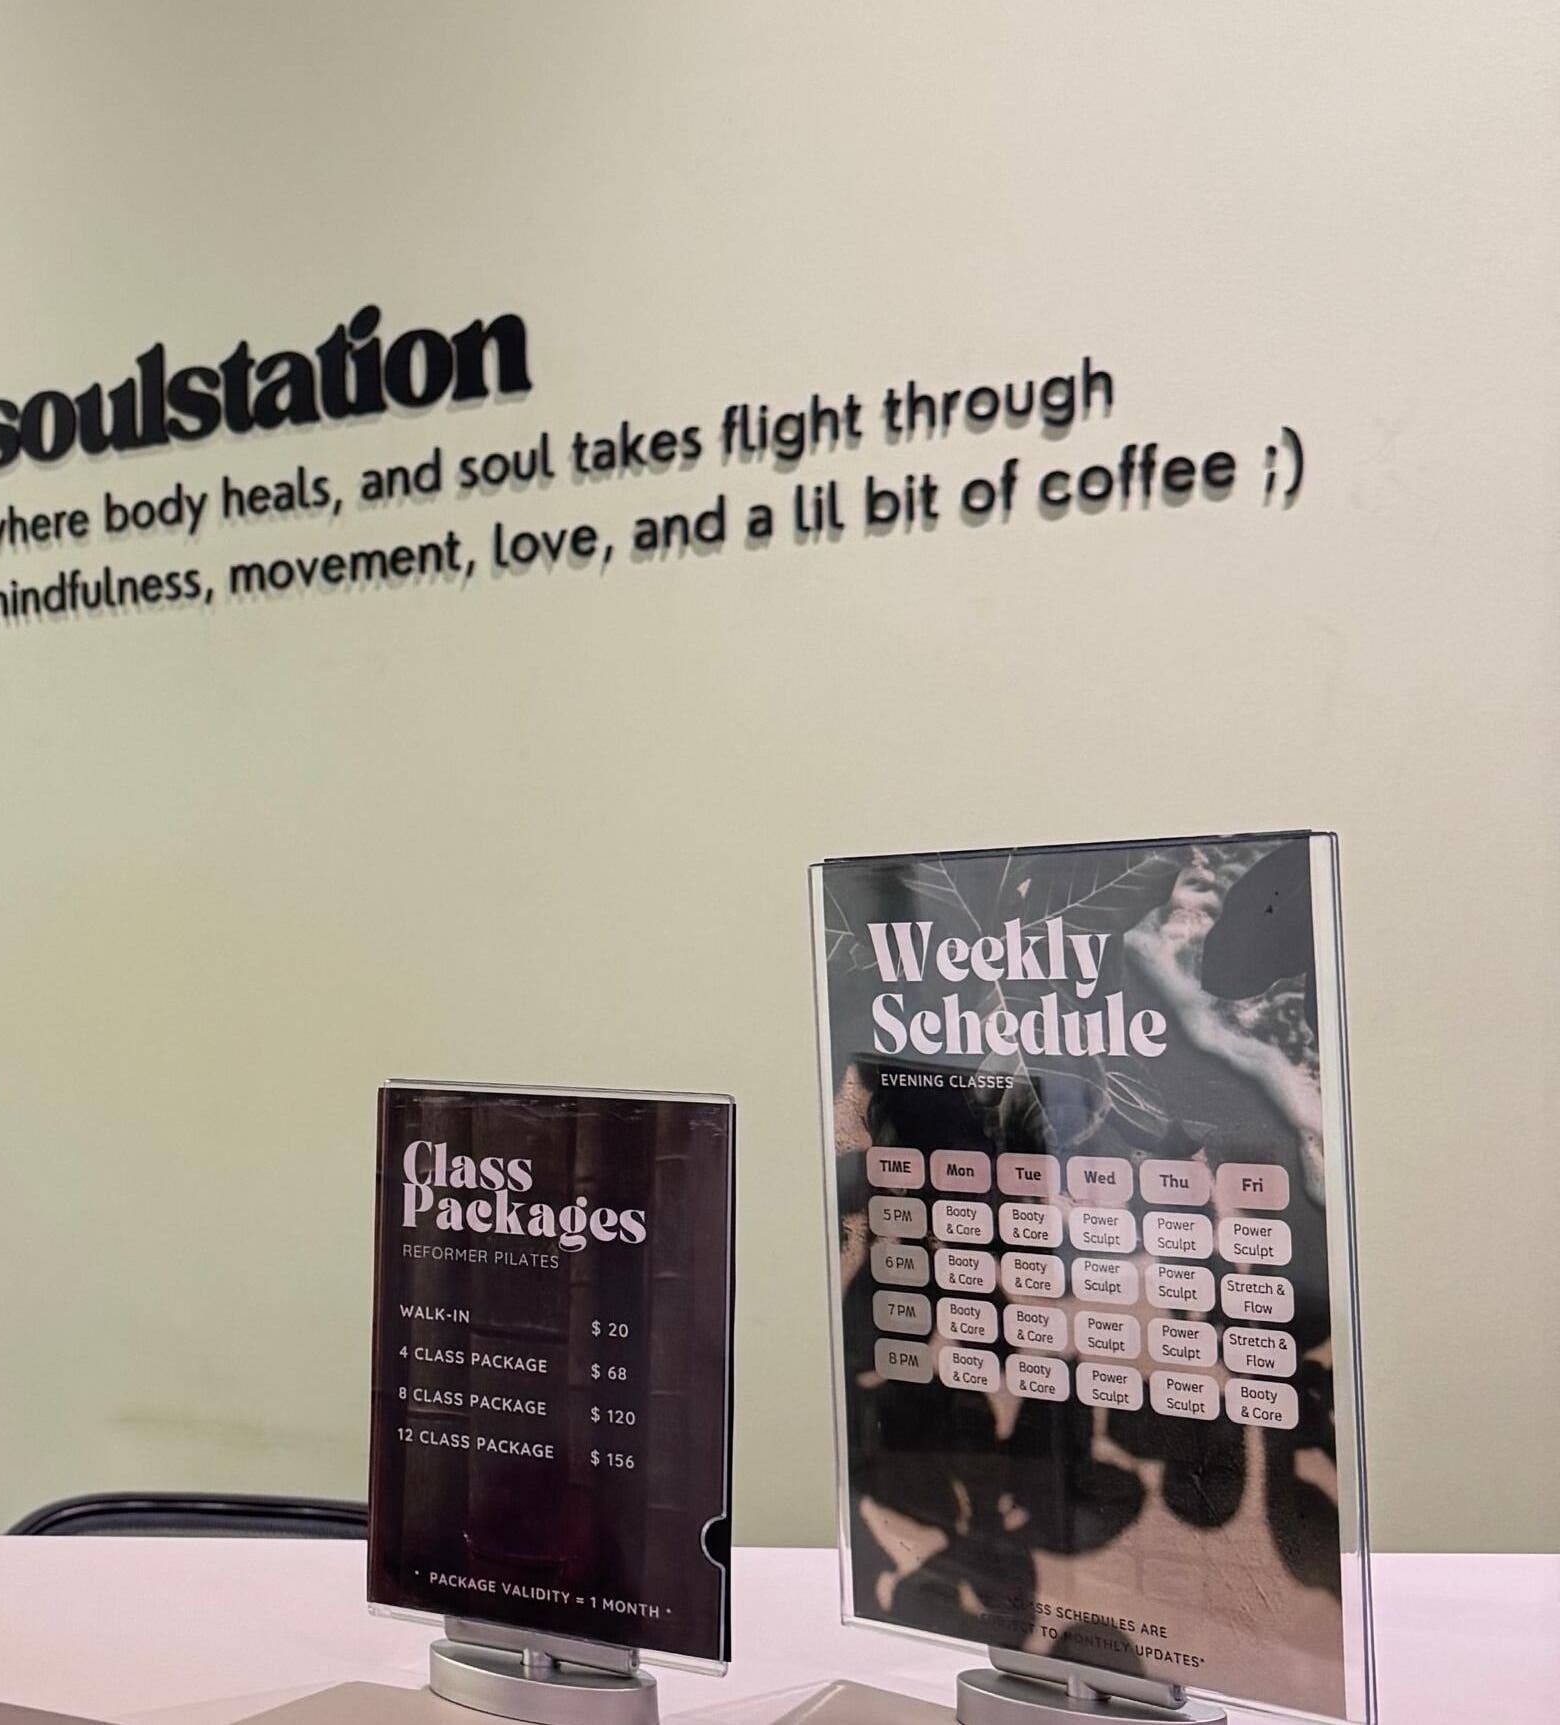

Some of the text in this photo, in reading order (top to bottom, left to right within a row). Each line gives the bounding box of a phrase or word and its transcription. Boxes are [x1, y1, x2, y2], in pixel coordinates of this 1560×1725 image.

[105, 483, 207, 535] body
[223, 467, 342, 517] heals,
[361, 448, 441, 500] and
[459, 433, 554, 489] soul
[572, 421, 701, 475] takes
[721, 394, 863, 461] flight
[883, 356, 1113, 428] through
[229, 530, 476, 594] movement,
[494, 523, 614, 565] love,
[633, 495, 726, 551] and
[747, 504, 773, 537] a
[794, 482, 844, 531] lil
[865, 475, 938, 526] bit
[961, 459, 1019, 513] of
[1039, 442, 1236, 507] coffee
[1265, 426, 1305, 496] ;)
[867, 916, 1111, 999] Weekly
[872, 991, 1168, 1058] Schedule
[880, 1073, 1014, 1090] EVENING CLASSES
[402, 1139, 533, 1192] Class
[879, 1159, 912, 1174] TIME
[946, 1164, 975, 1178] Mon
[1015, 1167, 1042, 1181] Tue
[1083, 1170, 1116, 1185] Wed
[1159, 1173, 1190, 1189] Thu
[1242, 1177, 1264, 1193] Fri
[402, 1183, 647, 1253] Packages
[883, 1209, 912, 1222] 5 PM
[946, 1206, 977, 1220] Booty
[1012, 1209, 1045, 1224] Booty
[1083, 1214, 1119, 1227] Power
[946, 1224, 981, 1236] & Core
[1157, 1218, 1195, 1231] Power
[1233, 1223, 1272, 1237] Power
[1013, 1228, 1049, 1240] & Core
[1083, 1232, 1120, 1248] Sculpt
[1157, 1237, 1196, 1252] Sculpt
[1233, 1243, 1274, 1259] Sculpt
[402, 1244, 560, 1269] REFORMER PILATES
[885, 1256, 915, 1270] 6 PM
[948, 1255, 979, 1270] Booty
[1014, 1258, 1047, 1274] Booty
[1084, 1261, 1120, 1274] Power
[1158, 1266, 1196, 1280] Power
[949, 1273, 984, 1286] & Core
[1015, 1277, 1051, 1290] & Core
[1084, 1279, 1122, 1294] Sculpt
[1158, 1286, 1198, 1301] Sculpt
[1227, 1280, 1286, 1296] Stretch &
[888, 1303, 916, 1318] 7 PM
[950, 1304, 981, 1319] Booty
[1244, 1301, 1273, 1314] Flow
[399, 1304, 629, 1338] WALK-IN $ 20
[1017, 1311, 1049, 1327] Booty
[1088, 1318, 1124, 1332] Power
[950, 1322, 985, 1336] & Core
[1017, 1329, 1053, 1344] & Core
[1162, 1325, 1199, 1340] Power
[1088, 1337, 1125, 1352] Sculpt
[1229, 1334, 1288, 1350] Stretch &
[889, 1352, 919, 1368] 8 PM
[1162, 1345, 1201, 1360] Sculpt
[399, 1346, 627, 1381] 4 CLASS PACKAGE $ 68
[953, 1353, 984, 1368] Booty
[1246, 1355, 1275, 1368] Flow
[1019, 1362, 1052, 1377] Booty
[953, 1371, 988, 1385] & Core
[1092, 1370, 1128, 1385] Power
[1019, 1380, 1056, 1394] & Core
[1166, 1378, 1204, 1393] Power
[1092, 1389, 1130, 1404] Sculpt
[1241, 1386, 1278, 1402] Booty
[398, 1387, 636, 1425] 8 CLASS PACKAGE $ 120
[1166, 1398, 1205, 1414] Sculpt
[1241, 1406, 1282, 1422] & Core
[397, 1428, 635, 1469] 12 CLASS PACKAGE $ 156
[429, 1572, 496, 1593] PACKAGE
[502, 1583, 570, 1604] VALIDITY
[589, 1596, 597, 1609] 1
[602, 1599, 659, 1618] MONTH
[1056, 1606, 1136, 1632] SCHEDULES
[1140, 1623, 1168, 1639] ARE
[1041, 1626, 1058, 1640] TO
[1063, 1631, 1130, 1653] MONTHLY
